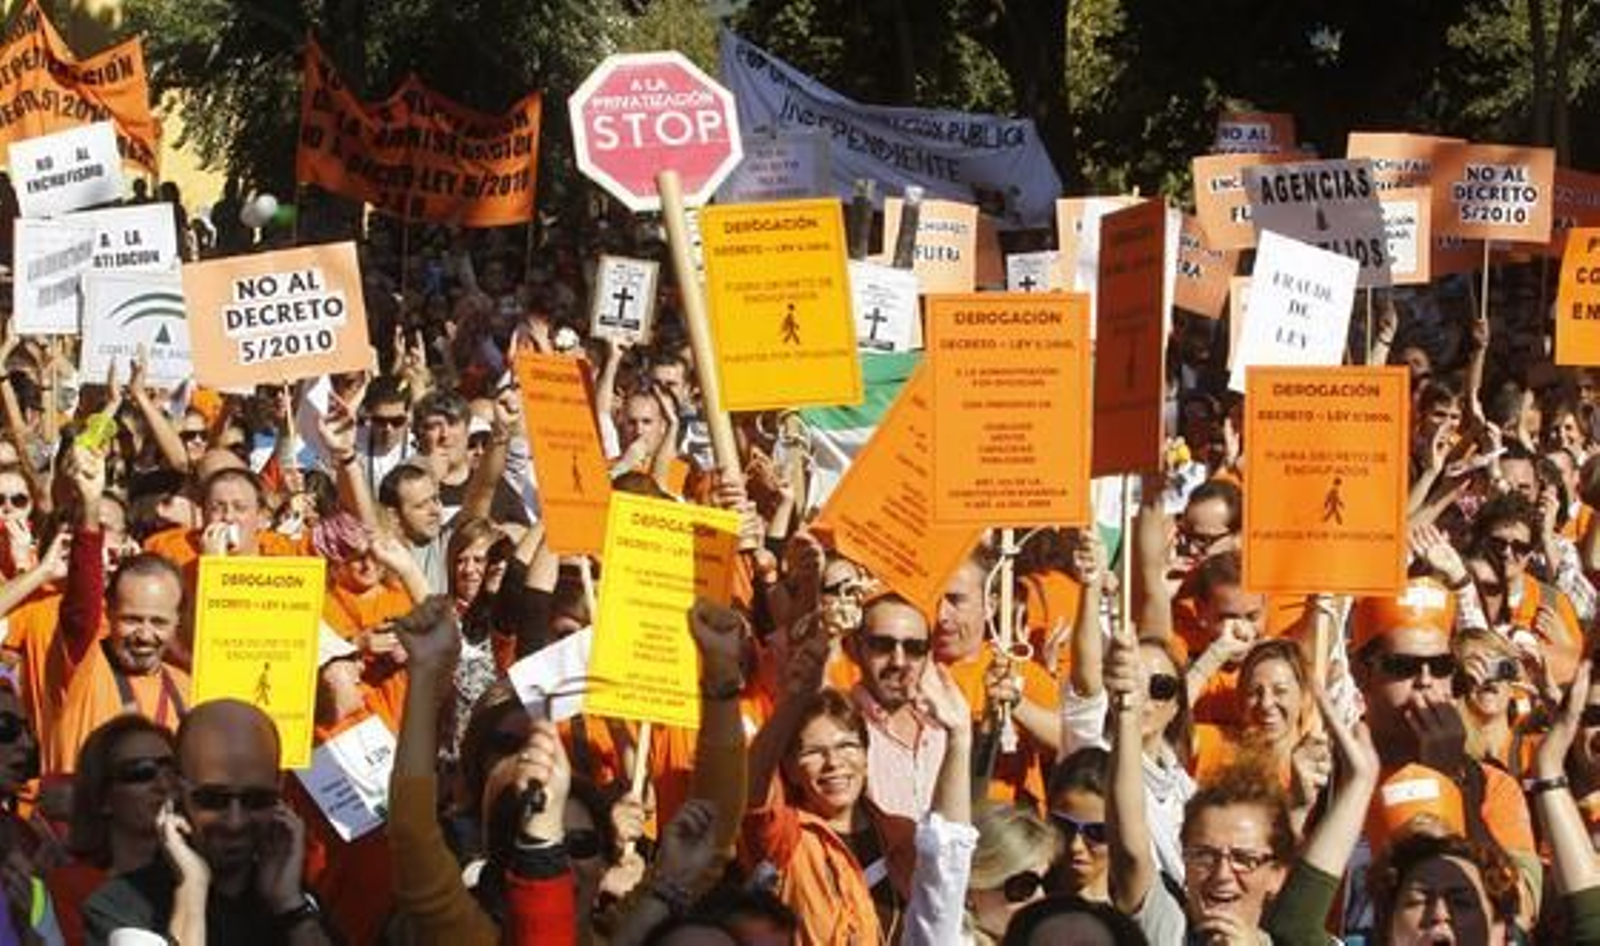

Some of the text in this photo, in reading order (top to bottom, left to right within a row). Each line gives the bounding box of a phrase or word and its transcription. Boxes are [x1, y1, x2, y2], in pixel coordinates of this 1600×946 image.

[593, 110, 722, 149] STOP
[35, 156, 55, 172] NO
[1466, 166, 1525, 182] NO AL
[1261, 167, 1371, 205] AGENCIAS
[1454, 184, 1538, 203] DECRETO
[1461, 205, 1526, 223] 5/2010
[723, 215, 819, 234] DEROGACIÓN
[124, 230, 143, 246] LA
[236, 270, 320, 301] NO AL
[226, 297, 344, 332] DECRETO
[953, 309, 1063, 326] DEROGACIÓN
[241, 330, 333, 362] 5/2010
[1272, 383, 1381, 398] DEROGACIÓN
